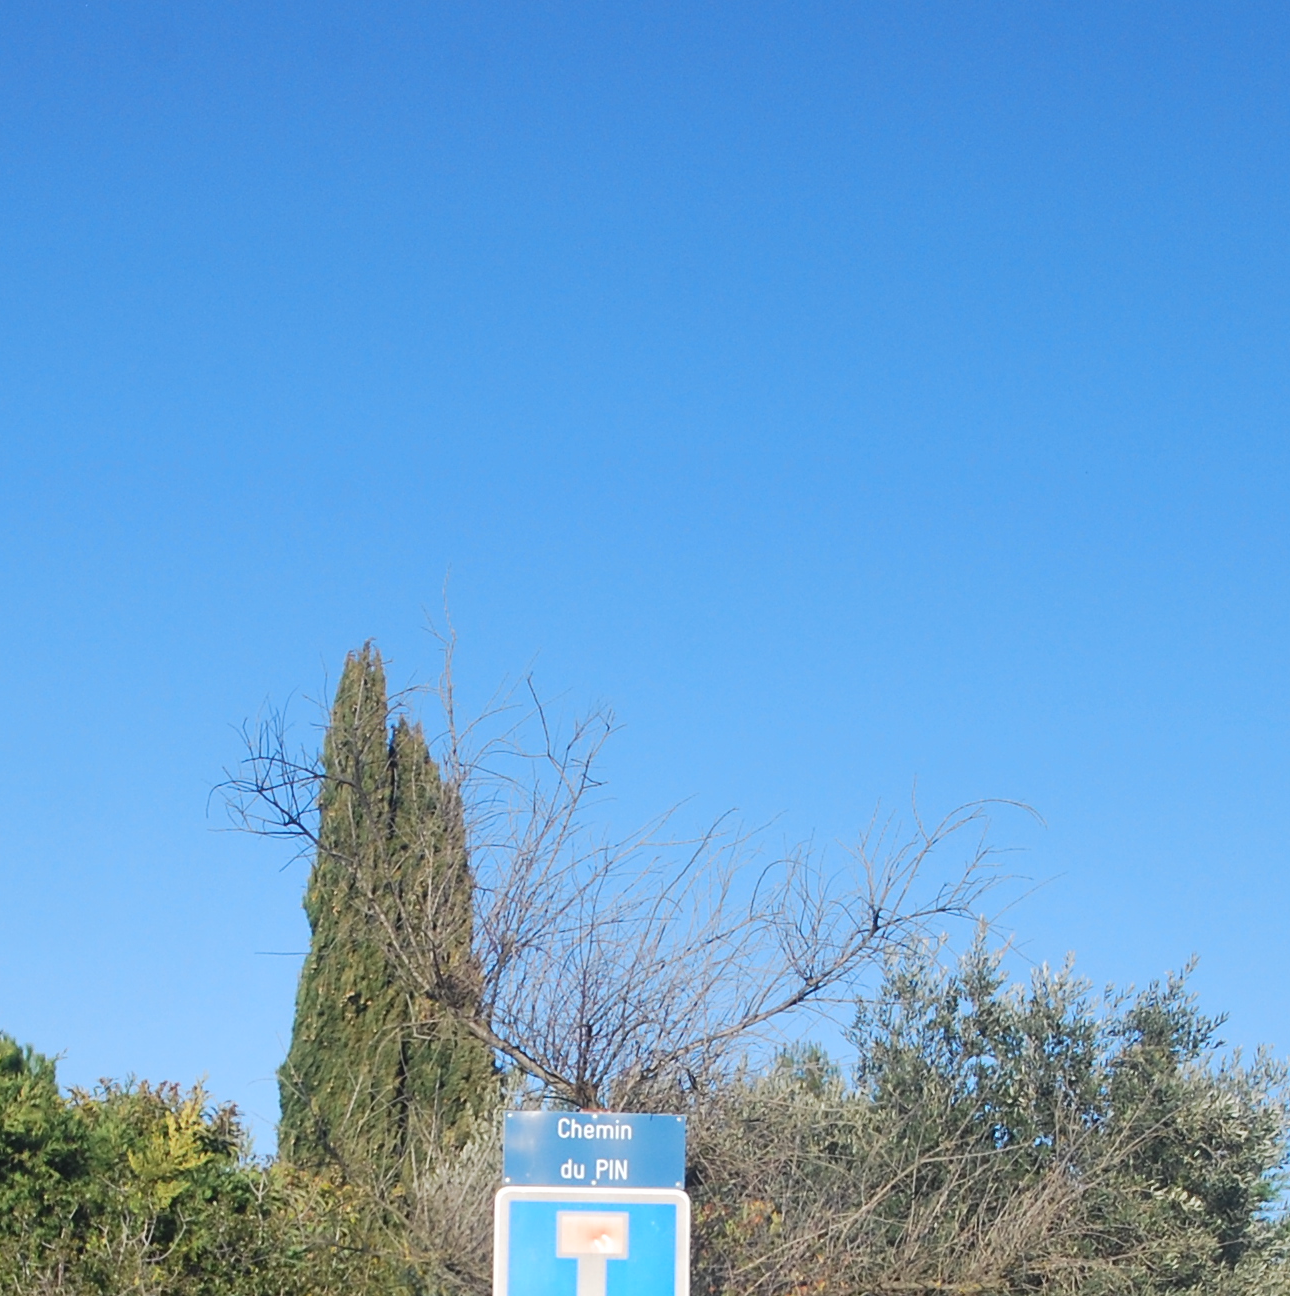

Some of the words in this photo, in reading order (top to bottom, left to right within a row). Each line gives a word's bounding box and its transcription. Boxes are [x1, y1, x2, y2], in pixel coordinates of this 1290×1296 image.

[557, 1117, 632, 1140] Chemin
[560, 1158, 585, 1179] du
[595, 1159, 628, 1180] PIN
